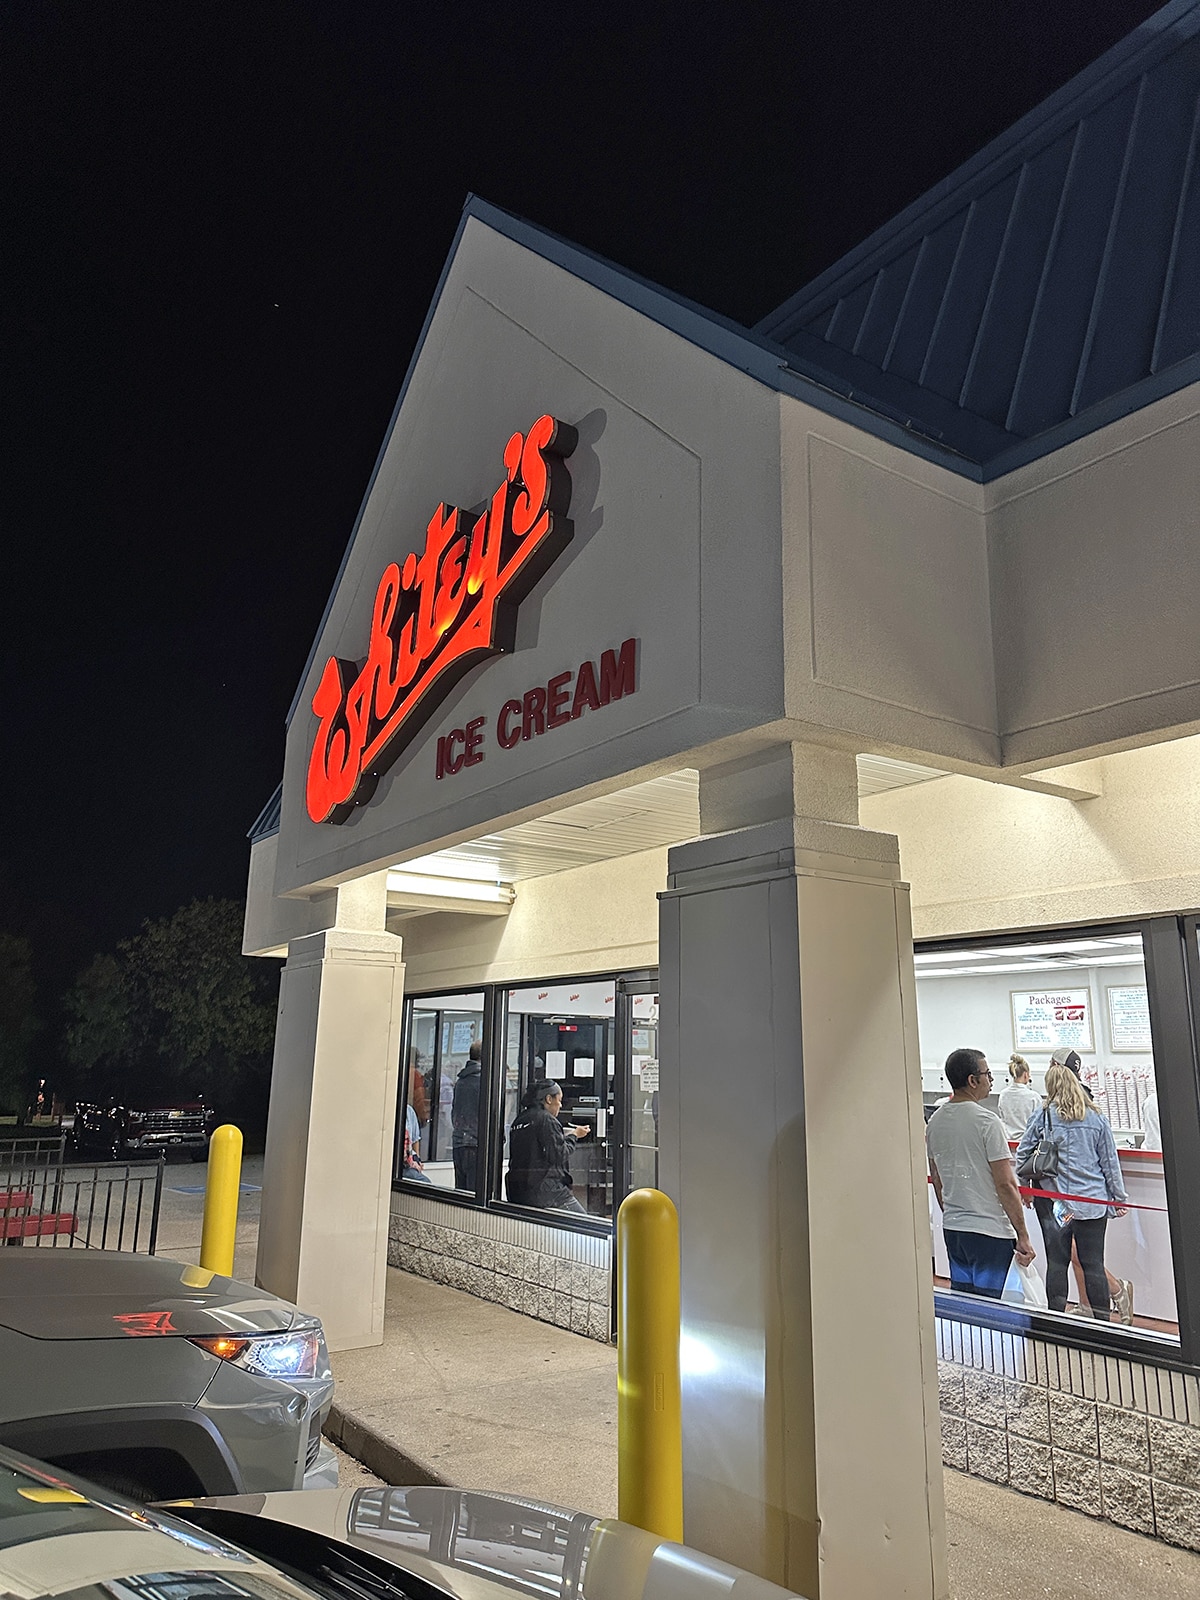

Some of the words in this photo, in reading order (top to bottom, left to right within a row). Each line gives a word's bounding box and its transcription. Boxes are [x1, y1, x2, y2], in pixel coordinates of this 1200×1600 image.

[435, 717, 485, 780] ICE
[497, 638, 638, 749] CREAM
[1029, 994, 1072, 1006] Packages
